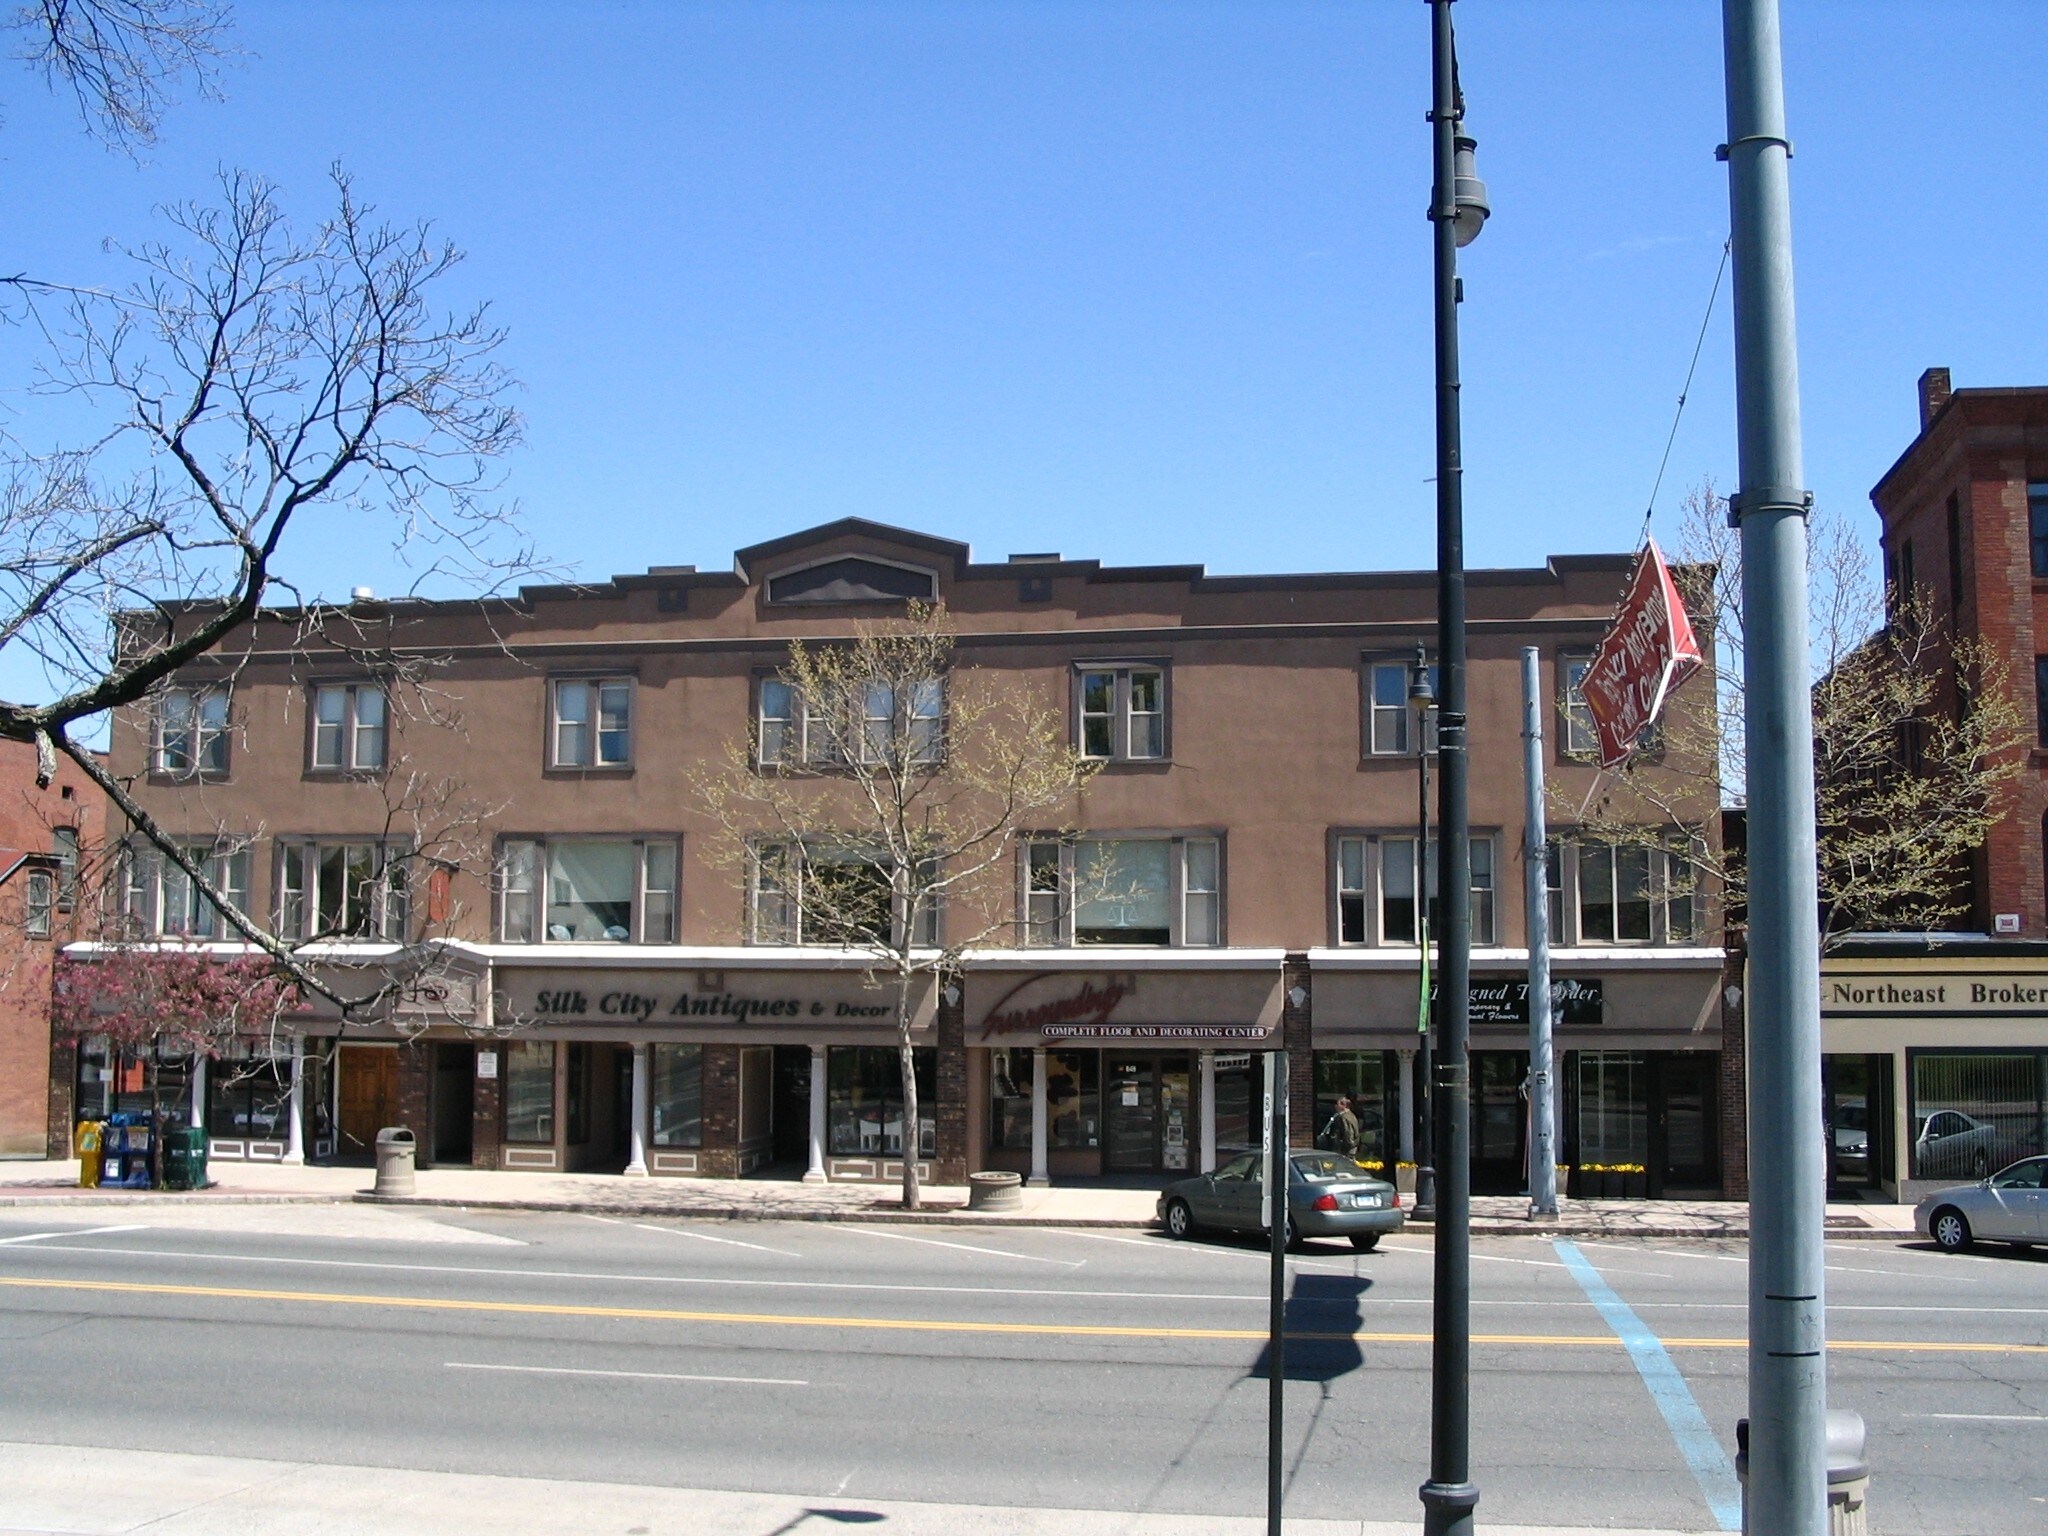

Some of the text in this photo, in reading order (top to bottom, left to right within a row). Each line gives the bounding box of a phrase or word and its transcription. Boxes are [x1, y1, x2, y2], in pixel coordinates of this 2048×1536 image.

[1833, 983, 2048, 1003] Northeast Broker
[535, 991, 890, 1023] Silk City Antiques & Decor
[1044, 1027, 1265, 1038] COMPLETE FLOOR AND DECORATING CENTER
